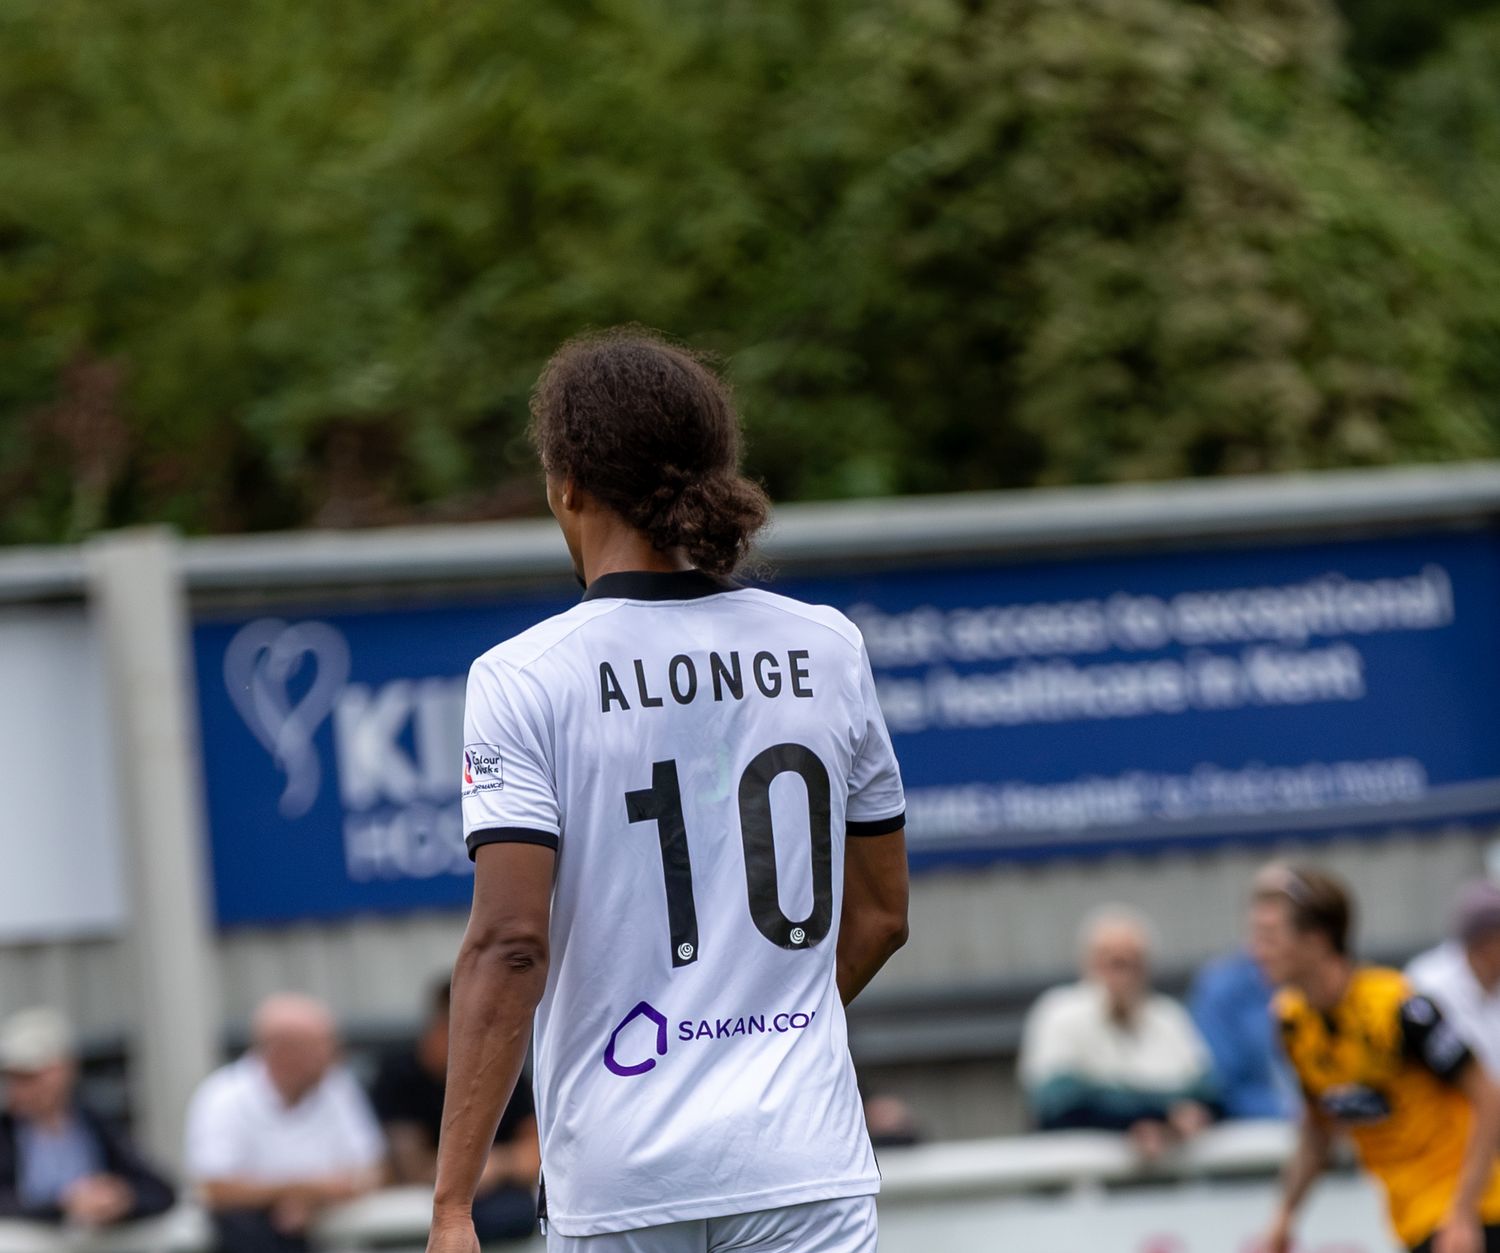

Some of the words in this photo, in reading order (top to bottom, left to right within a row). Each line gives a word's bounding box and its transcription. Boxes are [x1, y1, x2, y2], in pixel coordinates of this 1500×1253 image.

[598, 650, 814, 712] ALONGE
[625, 743, 833, 968] 10
[678, 1011, 816, 1041] SAKAN.CO
